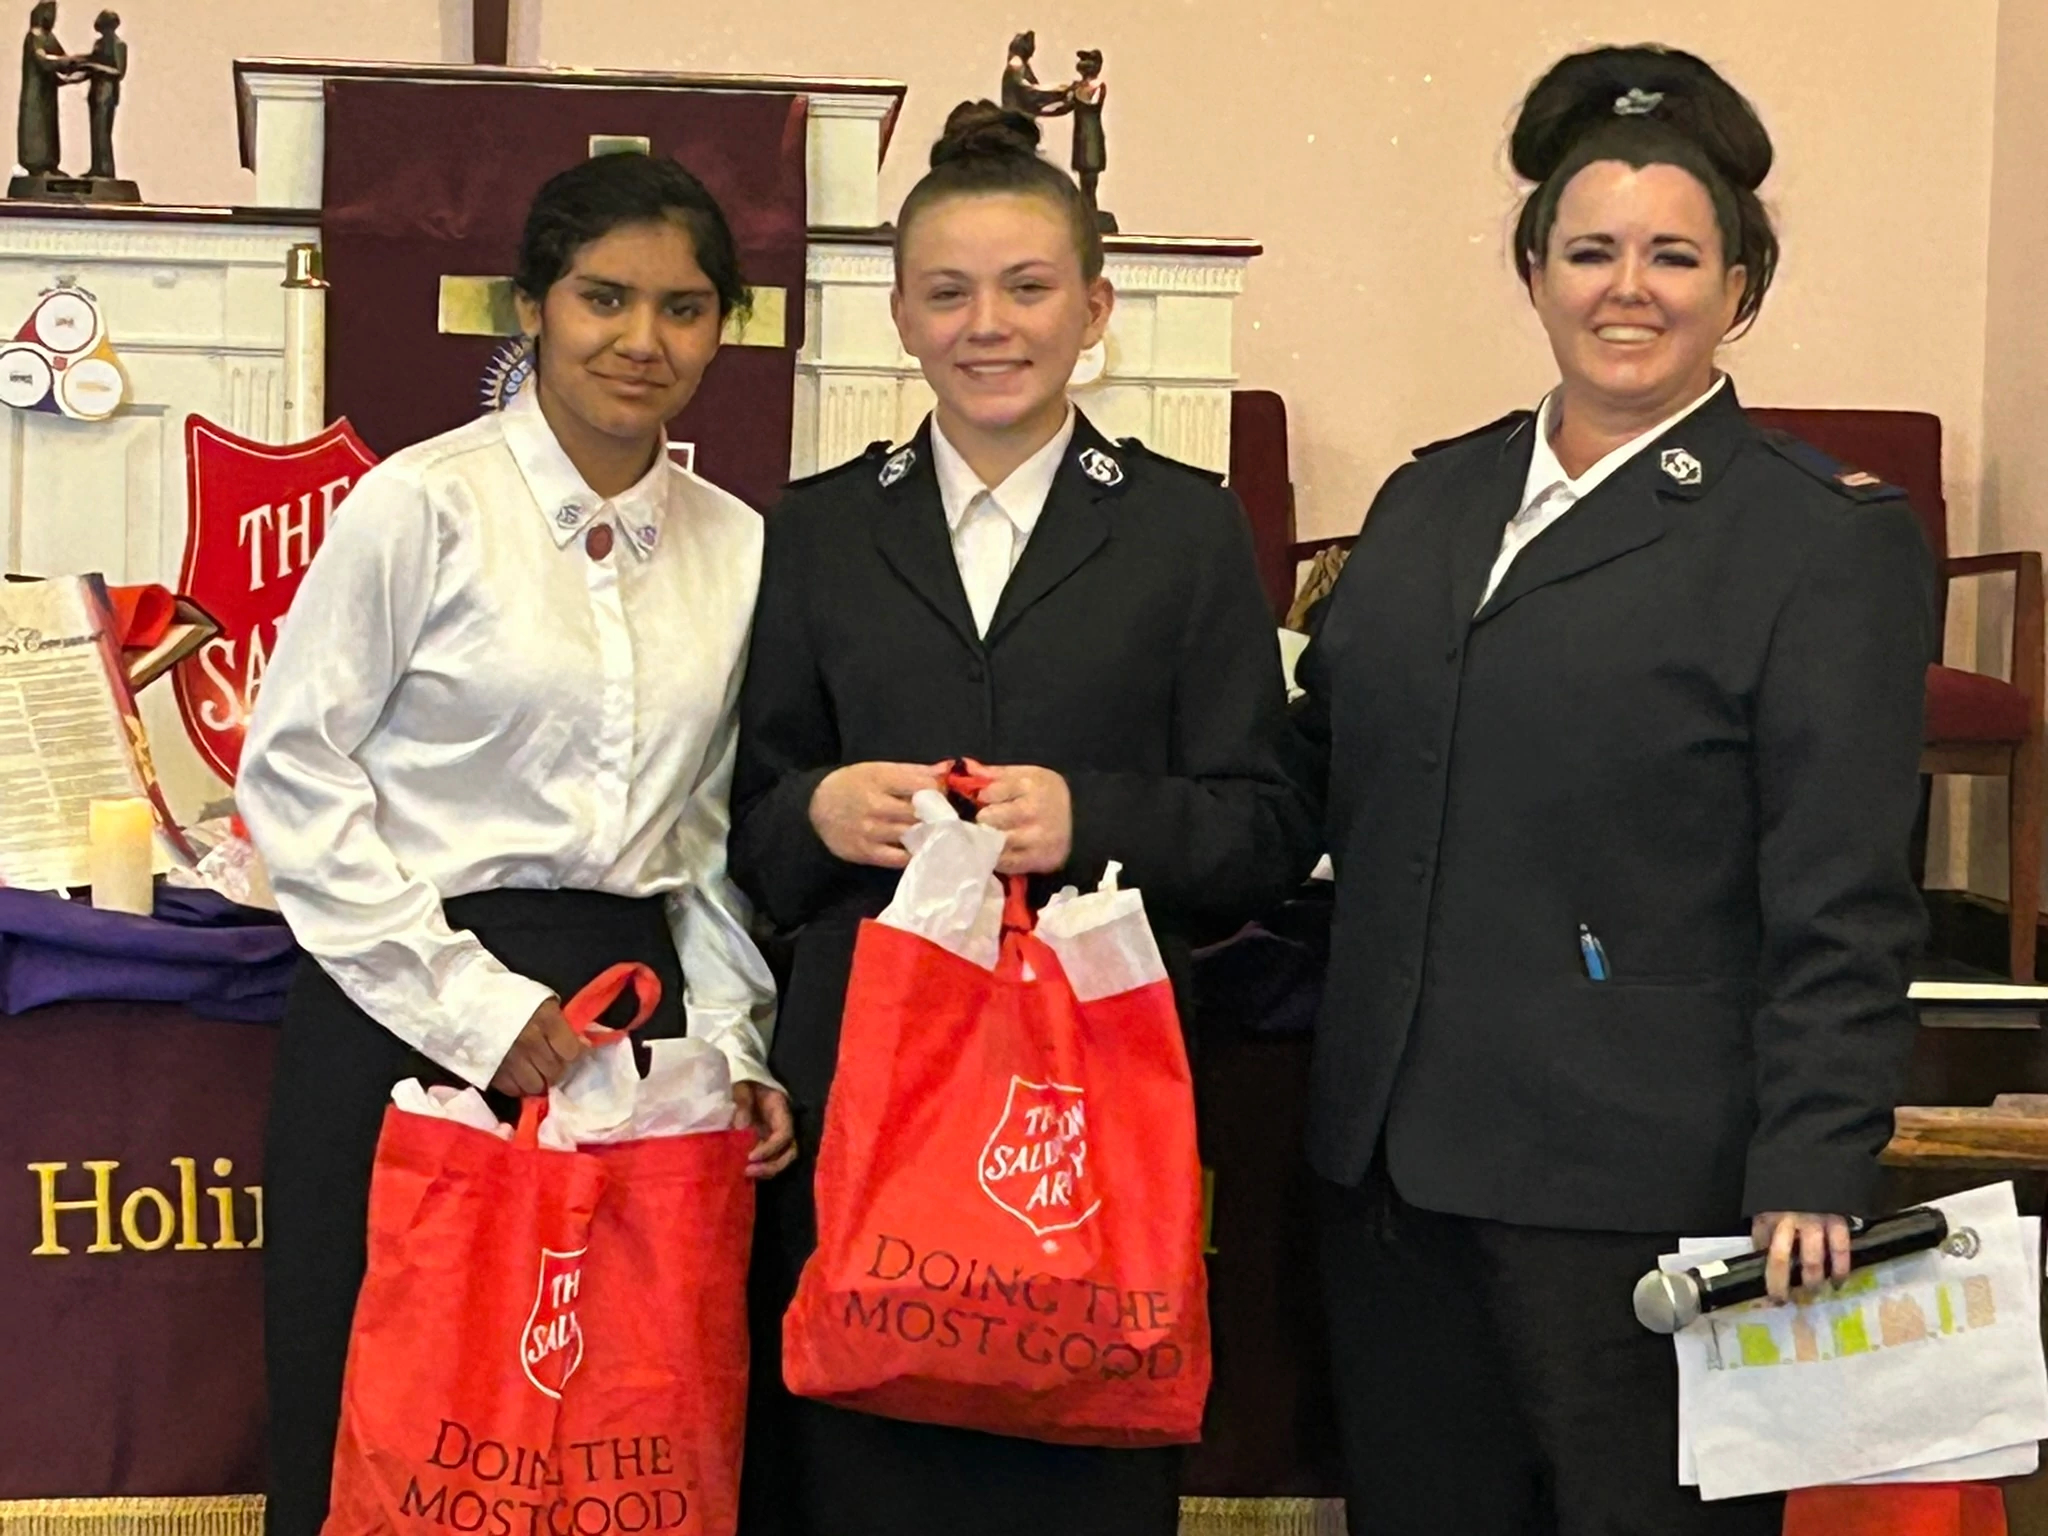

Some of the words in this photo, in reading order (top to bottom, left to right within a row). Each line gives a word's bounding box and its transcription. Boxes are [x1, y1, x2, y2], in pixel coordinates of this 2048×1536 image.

[866, 1233, 1058, 1314] DOING
[1076, 1277, 1178, 1331] THE
[843, 1289, 1007, 1356] MOST
[1016, 1321, 1183, 1381] GOOD
[570, 1434, 674, 1482] THE
